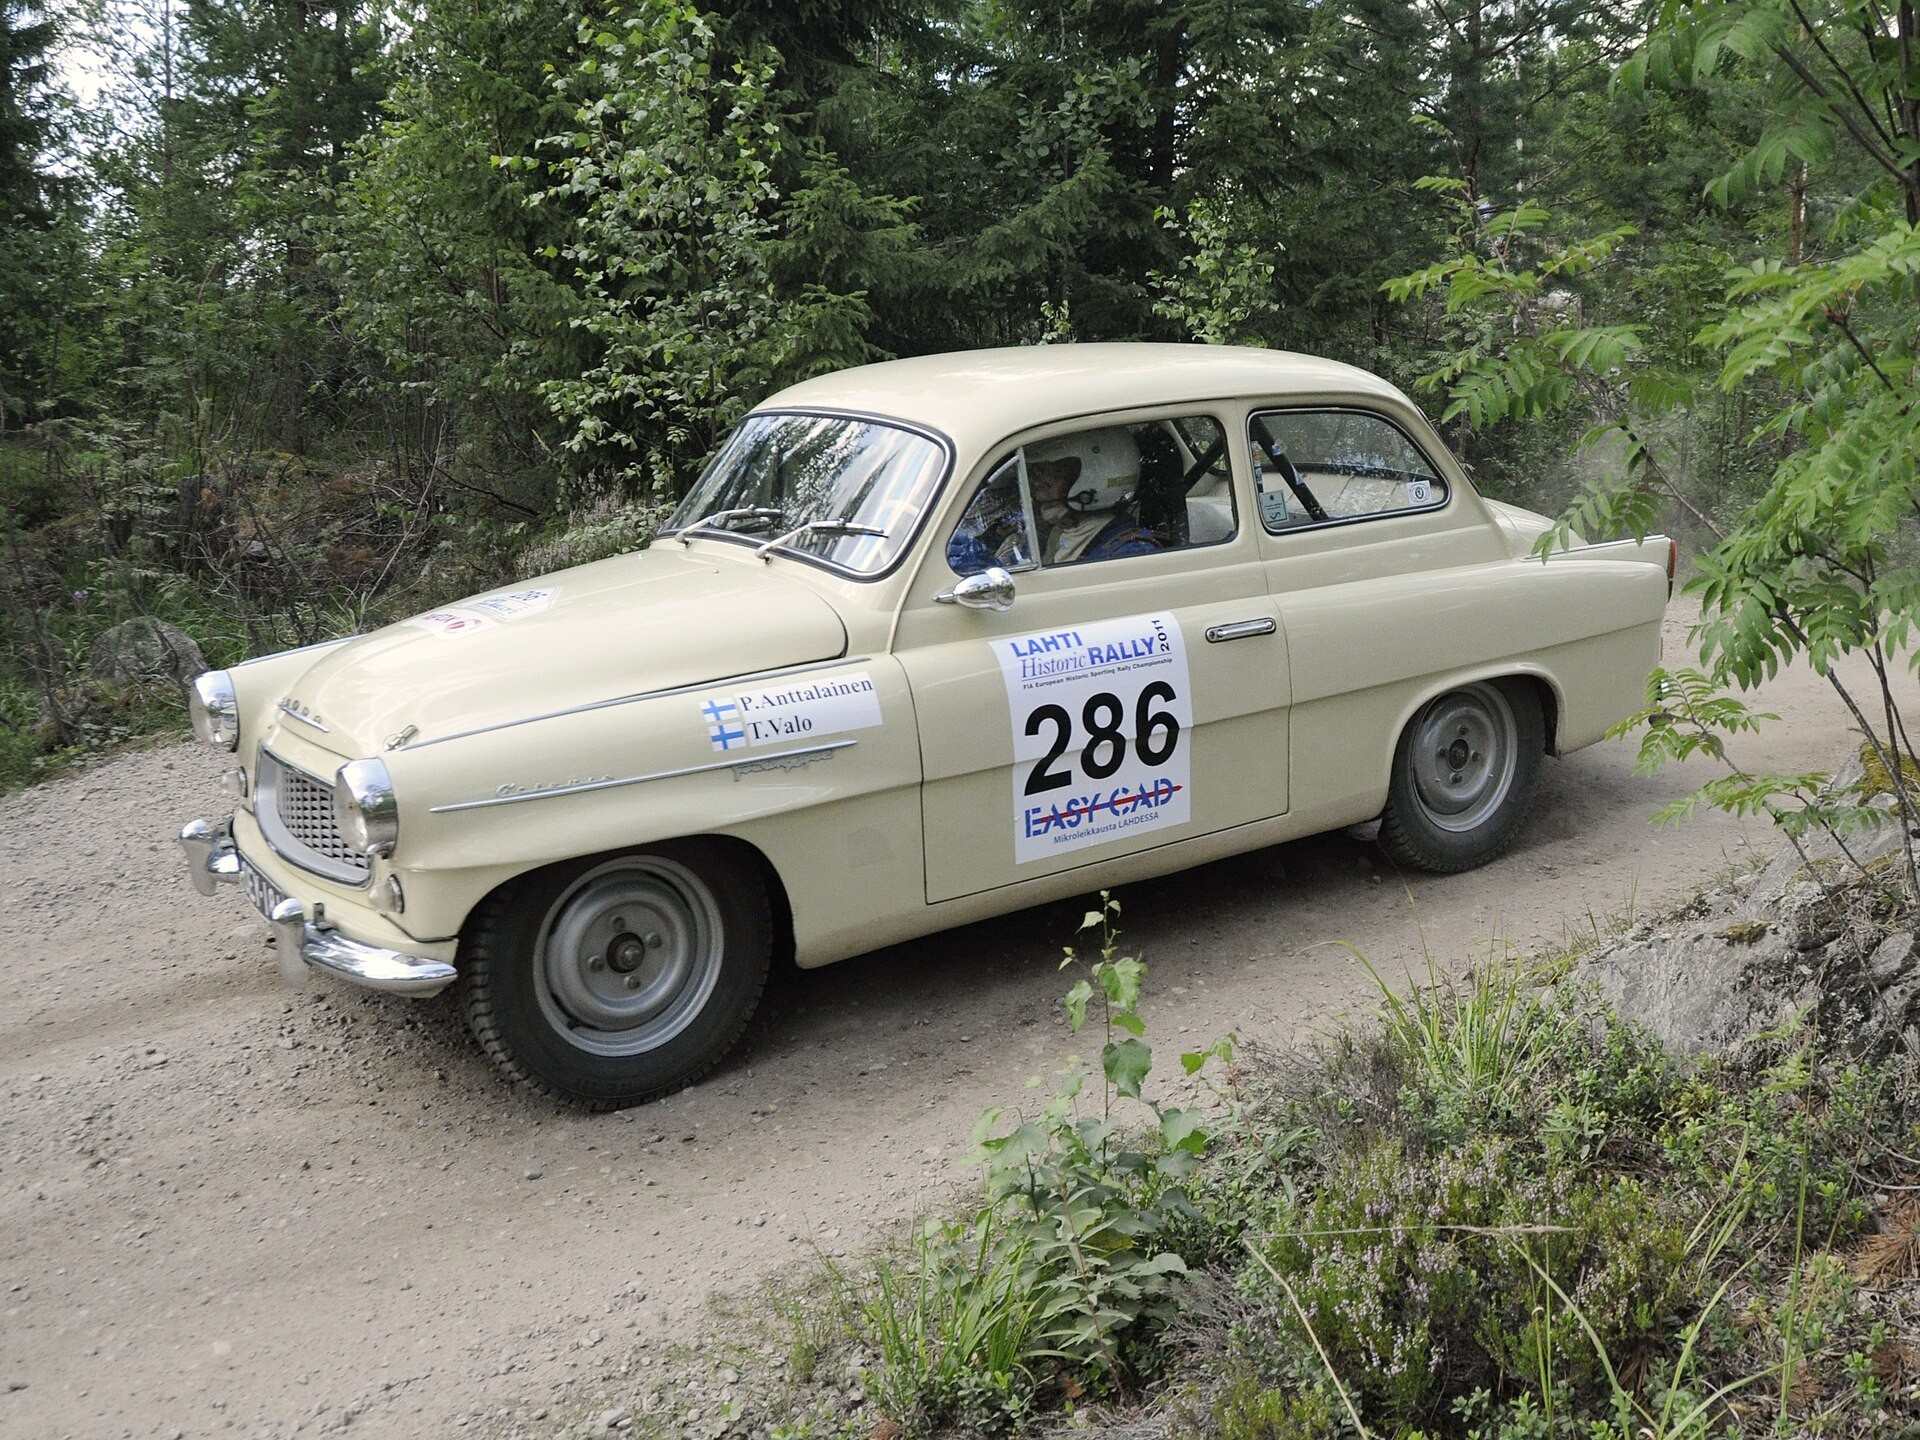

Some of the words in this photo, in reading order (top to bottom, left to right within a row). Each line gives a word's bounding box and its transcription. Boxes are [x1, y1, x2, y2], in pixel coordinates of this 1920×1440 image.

[1010, 632, 1083, 657] LAHTI
[1151, 619, 1170, 652] 2011
[1021, 651, 1087, 678] Historic
[1087, 636, 1155, 665] RALLY
[1035, 677, 1064, 688] European
[1066, 673, 1089, 682] Historic
[1090, 667, 1115, 678] Sporting
[1117, 664, 1131, 672] Rally
[1132, 657, 1172, 670] Championship
[738, 679, 874, 712] P.Anttalainen
[747, 715, 812, 740] T.Valo
[1024, 680, 1180, 796] 286
[1025, 792, 1102, 839] EASY
[1109, 778, 1174, 817] CAD
[1053, 823, 1117, 845] Mikroleikkausta
[1118, 811, 1159, 829] LAHDESSA
